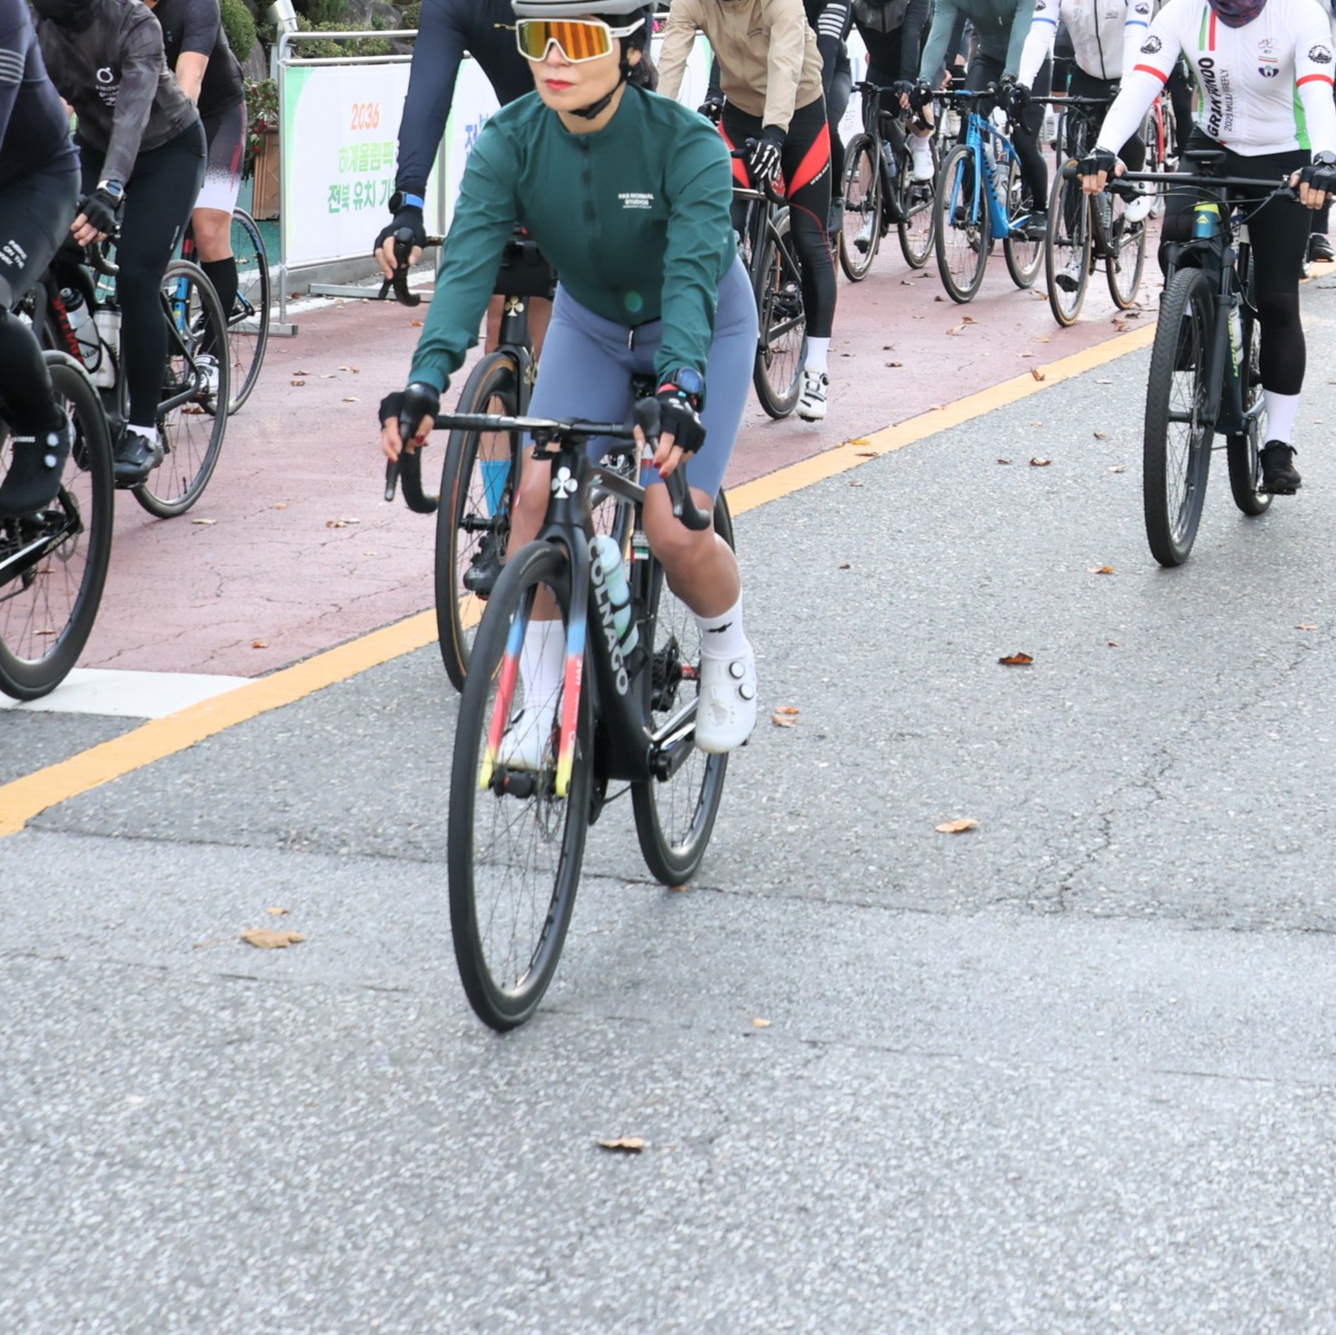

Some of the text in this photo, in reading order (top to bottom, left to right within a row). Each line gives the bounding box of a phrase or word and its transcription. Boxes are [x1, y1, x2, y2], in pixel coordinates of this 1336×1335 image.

[350, 102, 381, 131] 2036
[338, 141, 395, 174] 하계올림픽
[327, 182, 351, 214] 전북
[352, 180, 377, 210] 유치
[588, 536, 629, 696] COLNAGO
